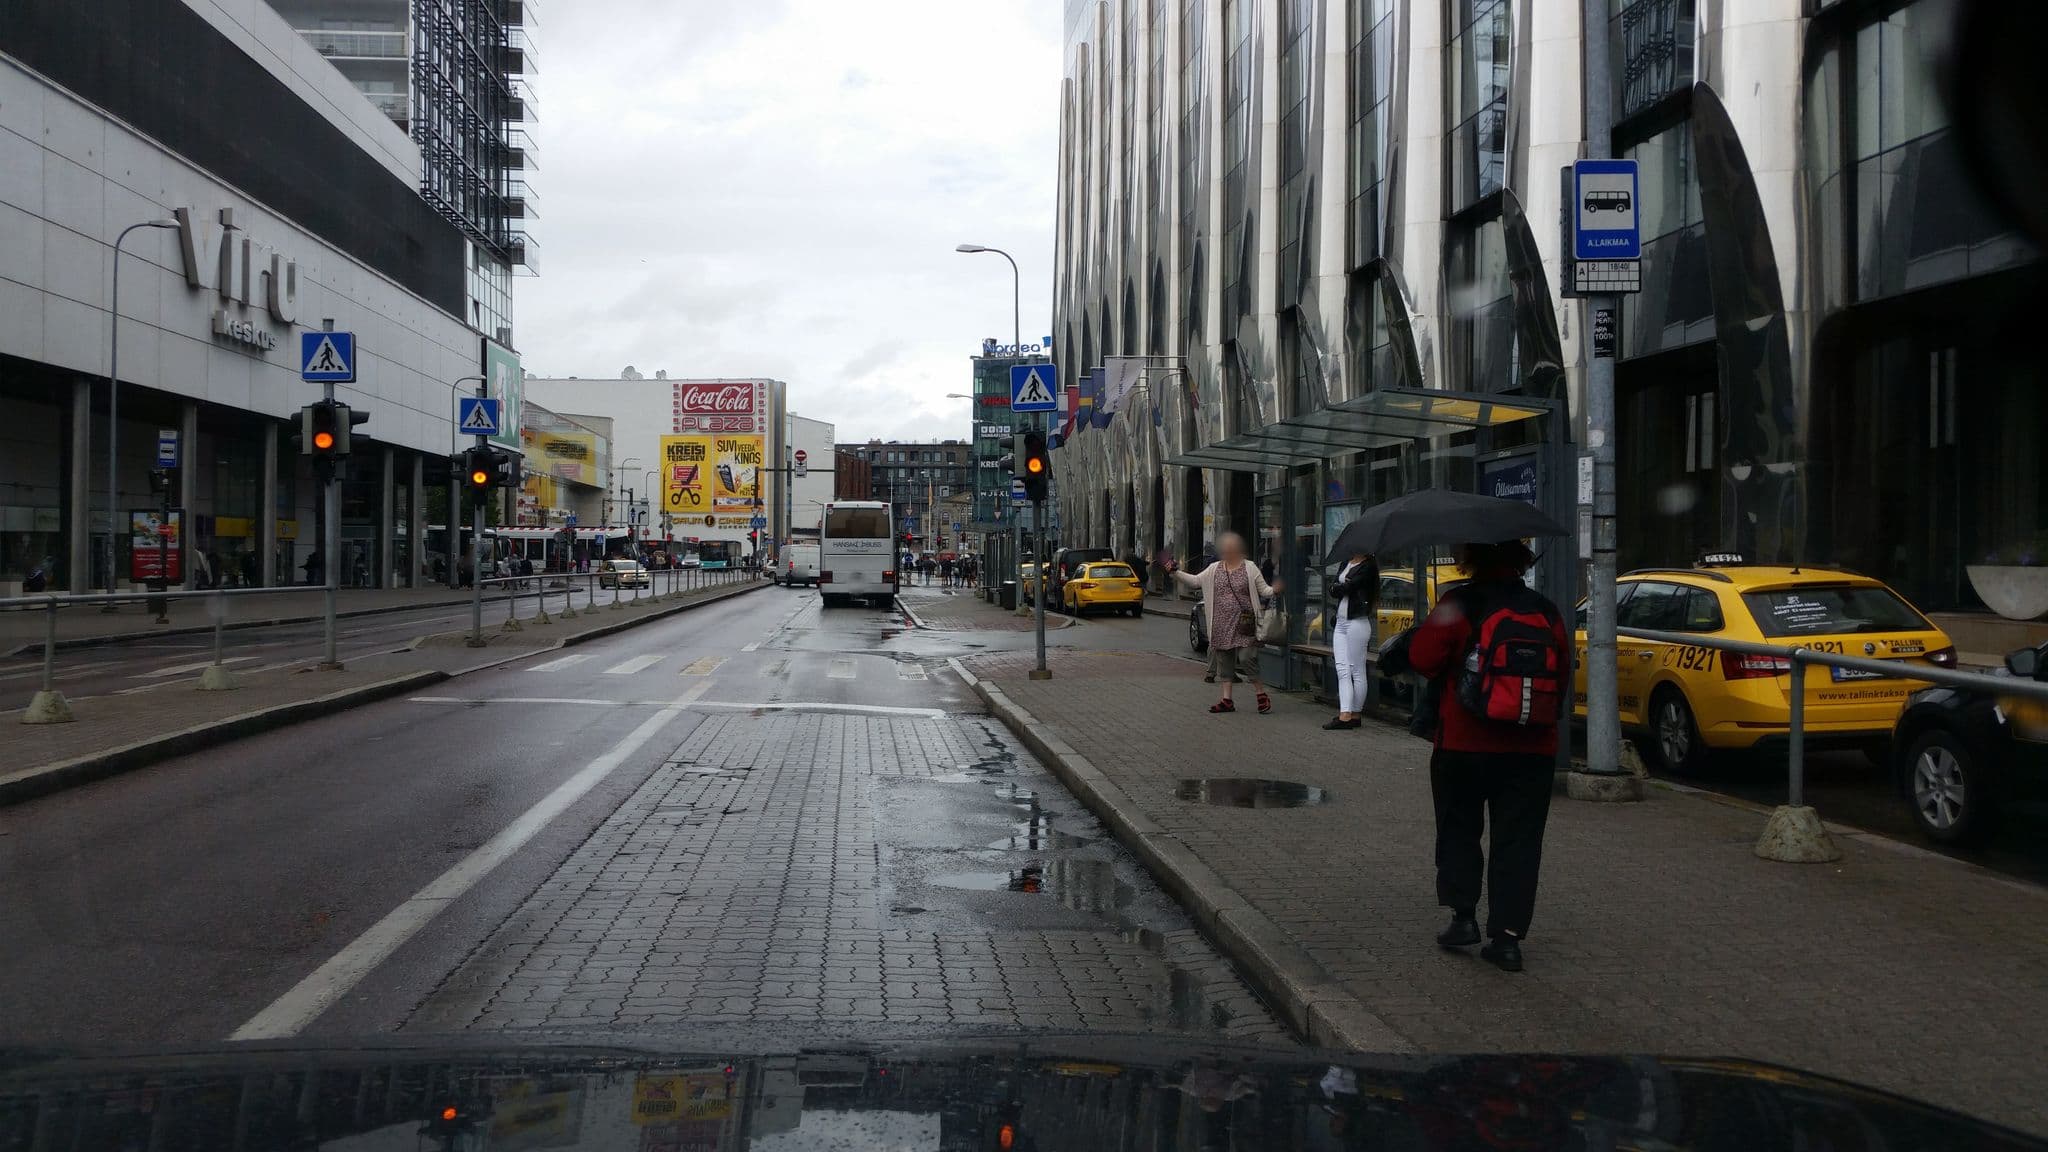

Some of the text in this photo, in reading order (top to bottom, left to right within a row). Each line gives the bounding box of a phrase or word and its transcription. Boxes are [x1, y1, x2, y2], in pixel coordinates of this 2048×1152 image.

[1587, 239, 1630, 247] A.LAIKMAA
[174, 207, 304, 324] Viru
[1591, 263, 1597, 271] 2
[213, 310, 280, 352] keskus
[983, 343, 1041, 353] Nordea
[683, 386, 752, 410] Coca-Cola
[667, 445, 706, 455] KREISI
[717, 440, 737, 452] SUVI
[735, 452, 761, 464] KINOS
[672, 517, 703, 525] ORUM
[1676, 645, 1715, 672] 1921
